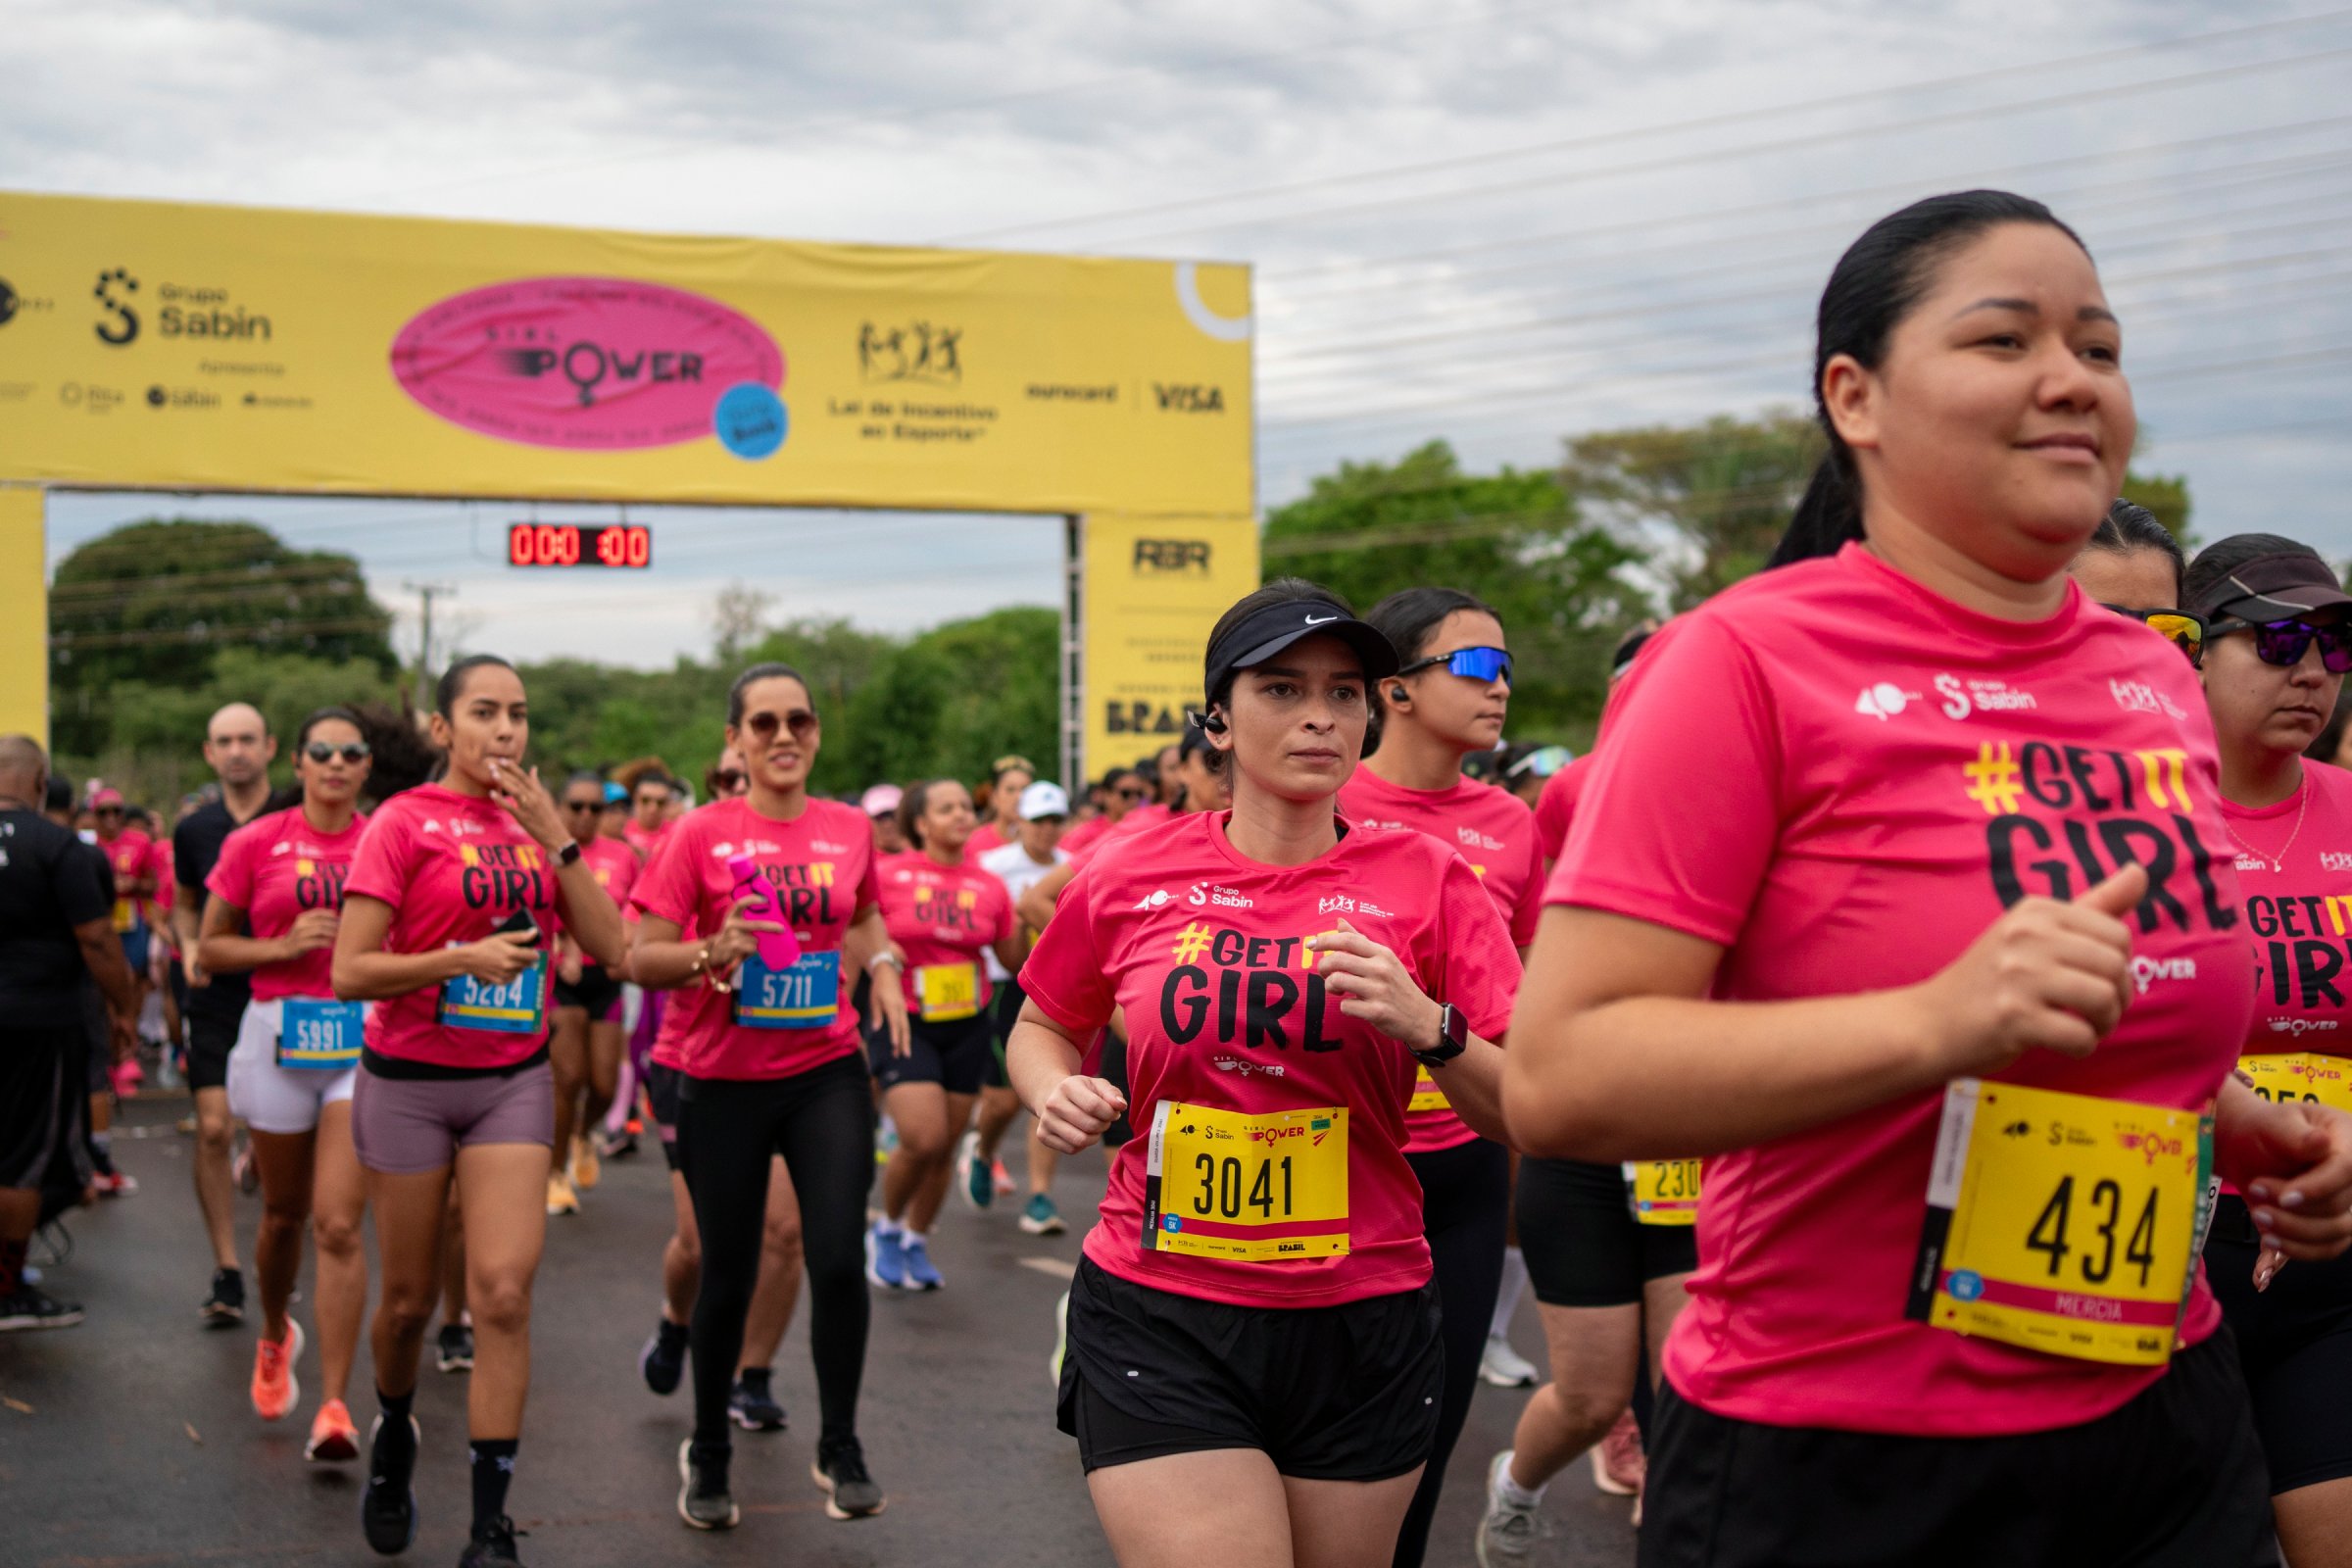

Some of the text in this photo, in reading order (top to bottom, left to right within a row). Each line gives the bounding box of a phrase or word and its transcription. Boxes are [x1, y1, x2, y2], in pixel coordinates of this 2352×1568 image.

[160, 305, 271, 341] Sabin
[493, 342, 704, 407] POWER
[1154, 383, 1224, 413] VISA
[1974, 688, 2037, 710] Sabin
[1986, 814, 2238, 934] GIRL
[2235, 858, 2266, 871] abin
[463, 867, 549, 910] GIRL
[776, 885, 841, 925] IRL
[1211, 894, 1253, 907] Sabin
[1213, 885, 1240, 896] Grupo
[762, 974, 812, 1007] 5711
[2132, 956, 2196, 994] OWER
[2253, 938, 2352, 1009] IR
[1160, 964, 1345, 1053] GIRL
[298, 1019, 343, 1051] 5991
[1214, 1061, 1285, 1077] POWER
[1246, 1127, 1304, 1148] POWER
[1194, 1152, 1292, 1218] 3041
[1654, 1160, 1703, 1197] 230
[1278, 1244, 1305, 1252] BRASIL
[2026, 1175, 2160, 1288] 434
[2055, 1294, 2123, 1321] MERCIA
